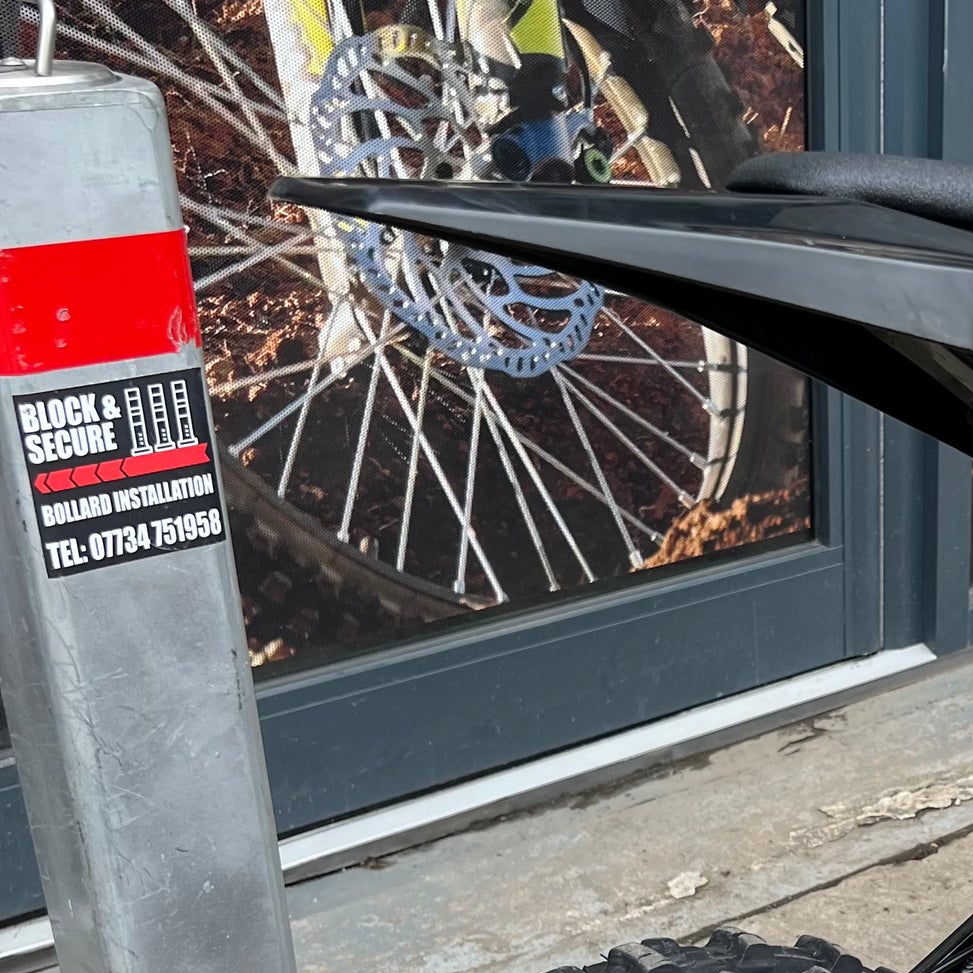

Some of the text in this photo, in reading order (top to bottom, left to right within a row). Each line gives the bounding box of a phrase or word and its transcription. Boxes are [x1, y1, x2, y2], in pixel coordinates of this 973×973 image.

[19, 393, 122, 433] BLOCK &
[24, 422, 118, 464] SECURE
[41, 473, 214, 527] BOLLARD INSTALLATION
[45, 508, 222, 570] TEL: 07734 751958
